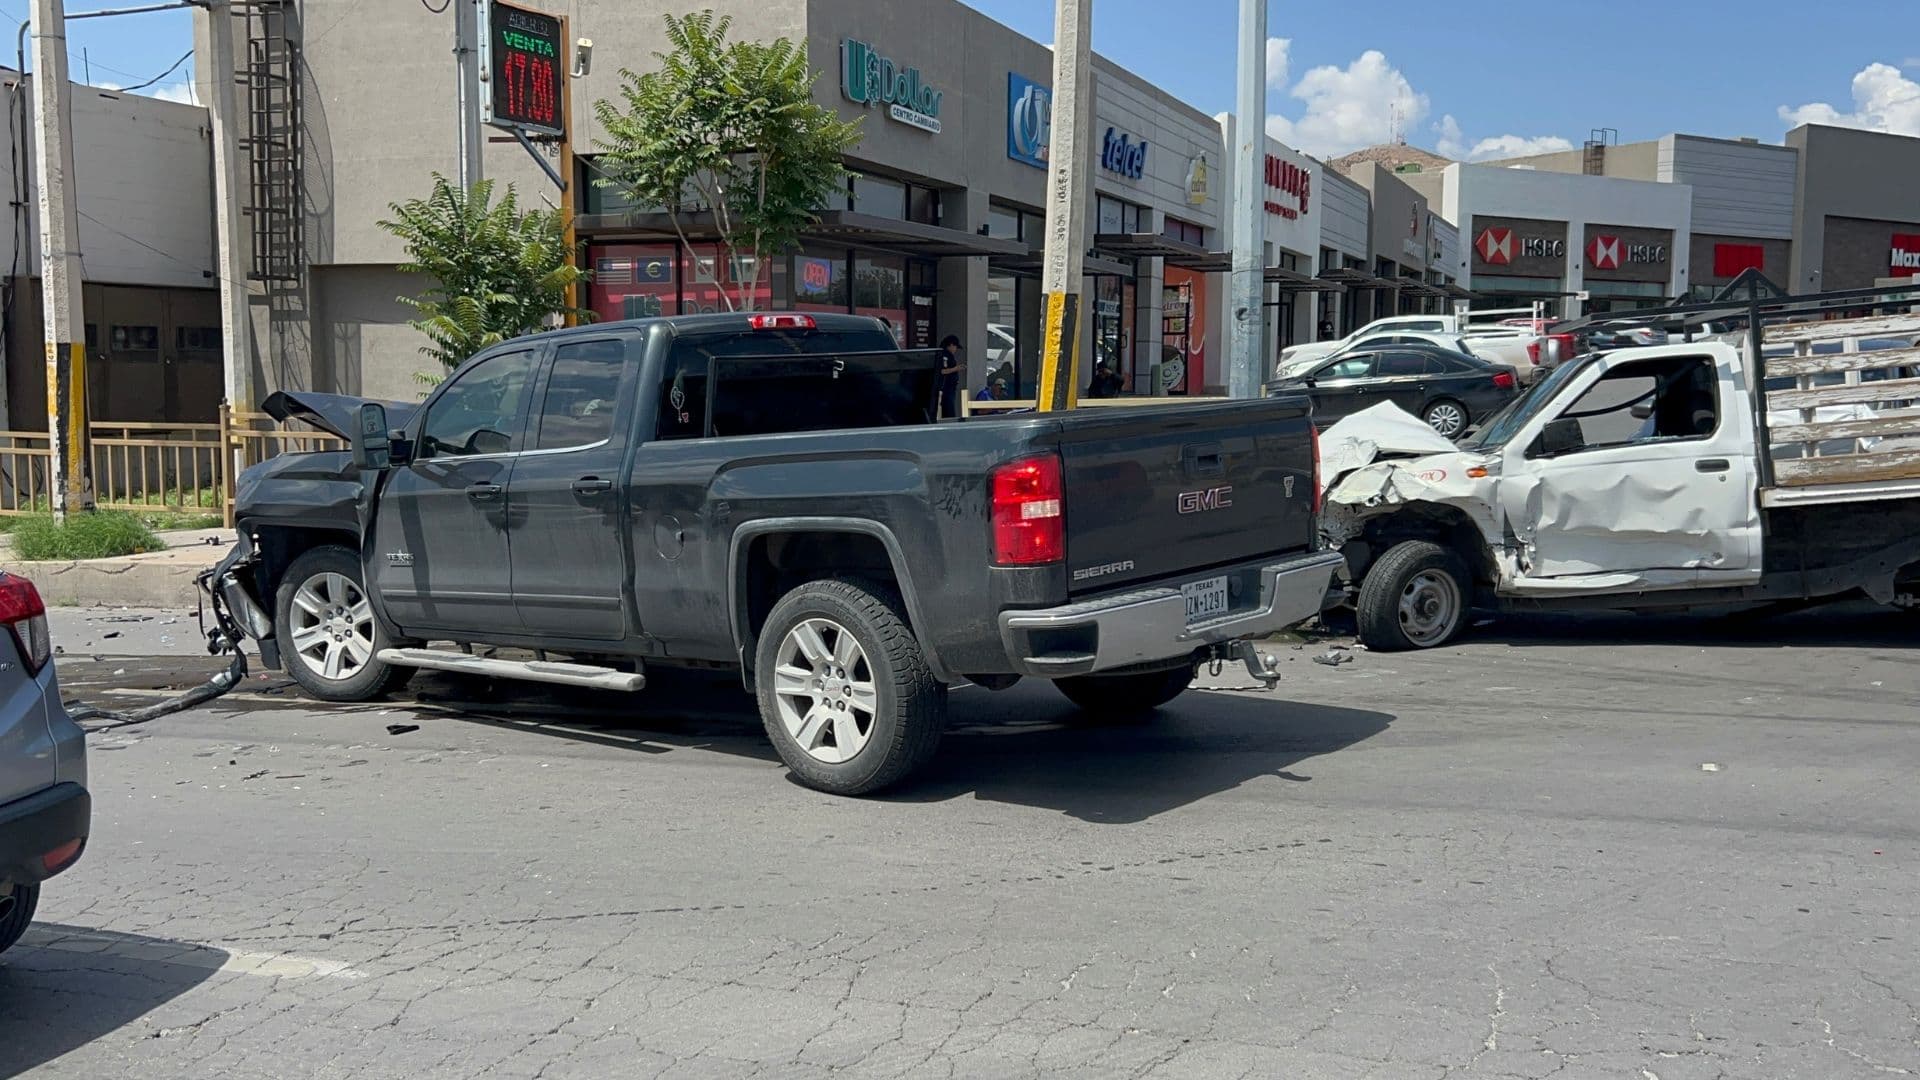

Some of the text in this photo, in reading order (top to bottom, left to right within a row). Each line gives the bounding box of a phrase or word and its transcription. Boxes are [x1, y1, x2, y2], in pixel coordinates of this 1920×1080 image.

[503, 30, 554, 57] VENTA
[880, 56, 943, 117] Dollar
[893, 107, 940, 131] CENTRO CAMBIARIO
[1101, 127, 1148, 179] telcel
[1522, 238, 1563, 258] HSBC
[1628, 245, 1665, 263] HSBC
[804, 262, 829, 287] OPEN
[1178, 486, 1232, 514] GMC
[1073, 560, 1134, 580] SIERRA
[1195, 580, 1213, 591] TEXAS
